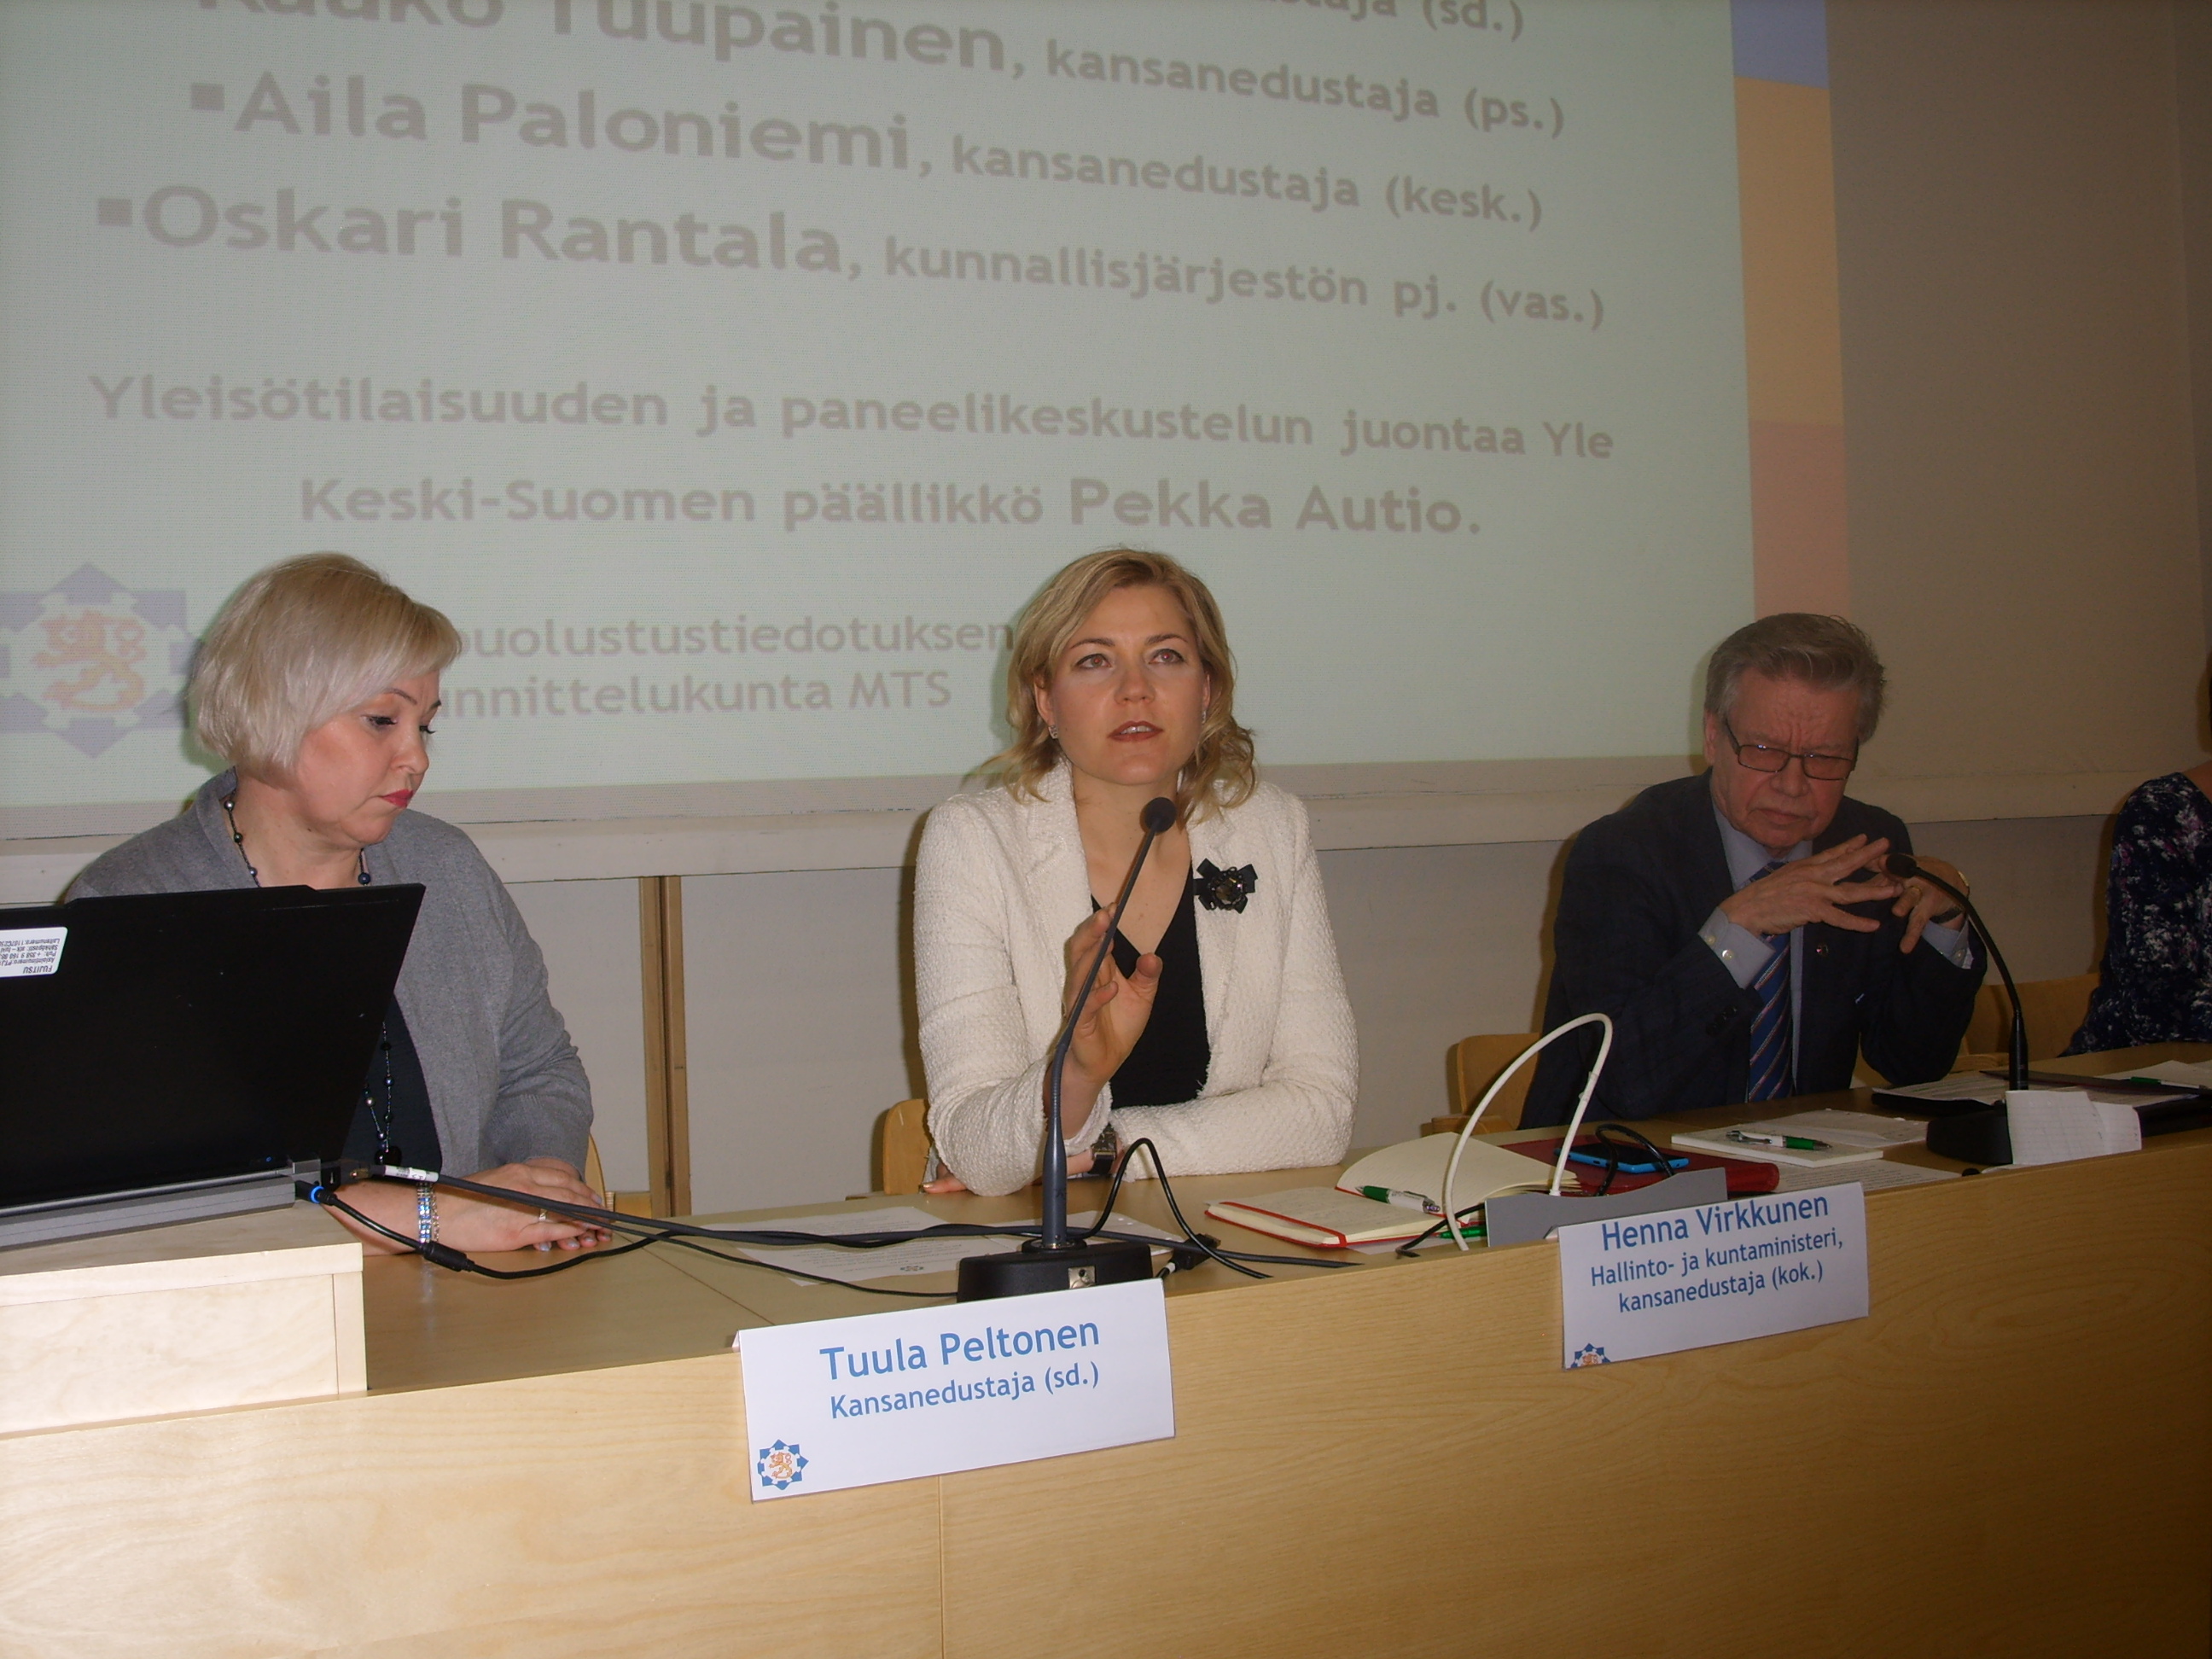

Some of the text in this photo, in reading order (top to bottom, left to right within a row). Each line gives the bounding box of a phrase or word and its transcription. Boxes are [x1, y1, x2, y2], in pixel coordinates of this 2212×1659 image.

[1046, 38, 1440, 122] kansanedustaja
[1464, 87, 1564, 140] (ps.)
[233, 71, 1544, 231] Aila Paloniemi, kansanedustaja (kesk.)
[143, 184, 1605, 332] Oskari Rantala, kunnallisjärjestön pj. (vas.)
[87, 374, 1615, 460] Yleisötilaisuuden ja paneelikeskustelun juontaa Yle
[300, 476, 1482, 536] Keski-Suomen päällikkö Pekka Autio.
[461, 615, 1014, 659] uolustustiedotuksen
[848, 670, 952, 710] MTS
[23, 965, 52, 974] FUJITSU
[1602, 1196, 1829, 1251] Henna Virkkunen
[1591, 1227, 1843, 1286] Hallinto- ja kuntaministeri,
[1619, 1260, 1824, 1313] kansanedustaja (kok.)
[819, 1321, 1100, 1380] Tuula Peltonen
[830, 1361, 1099, 1419] Kansanedustaja (sd.)
